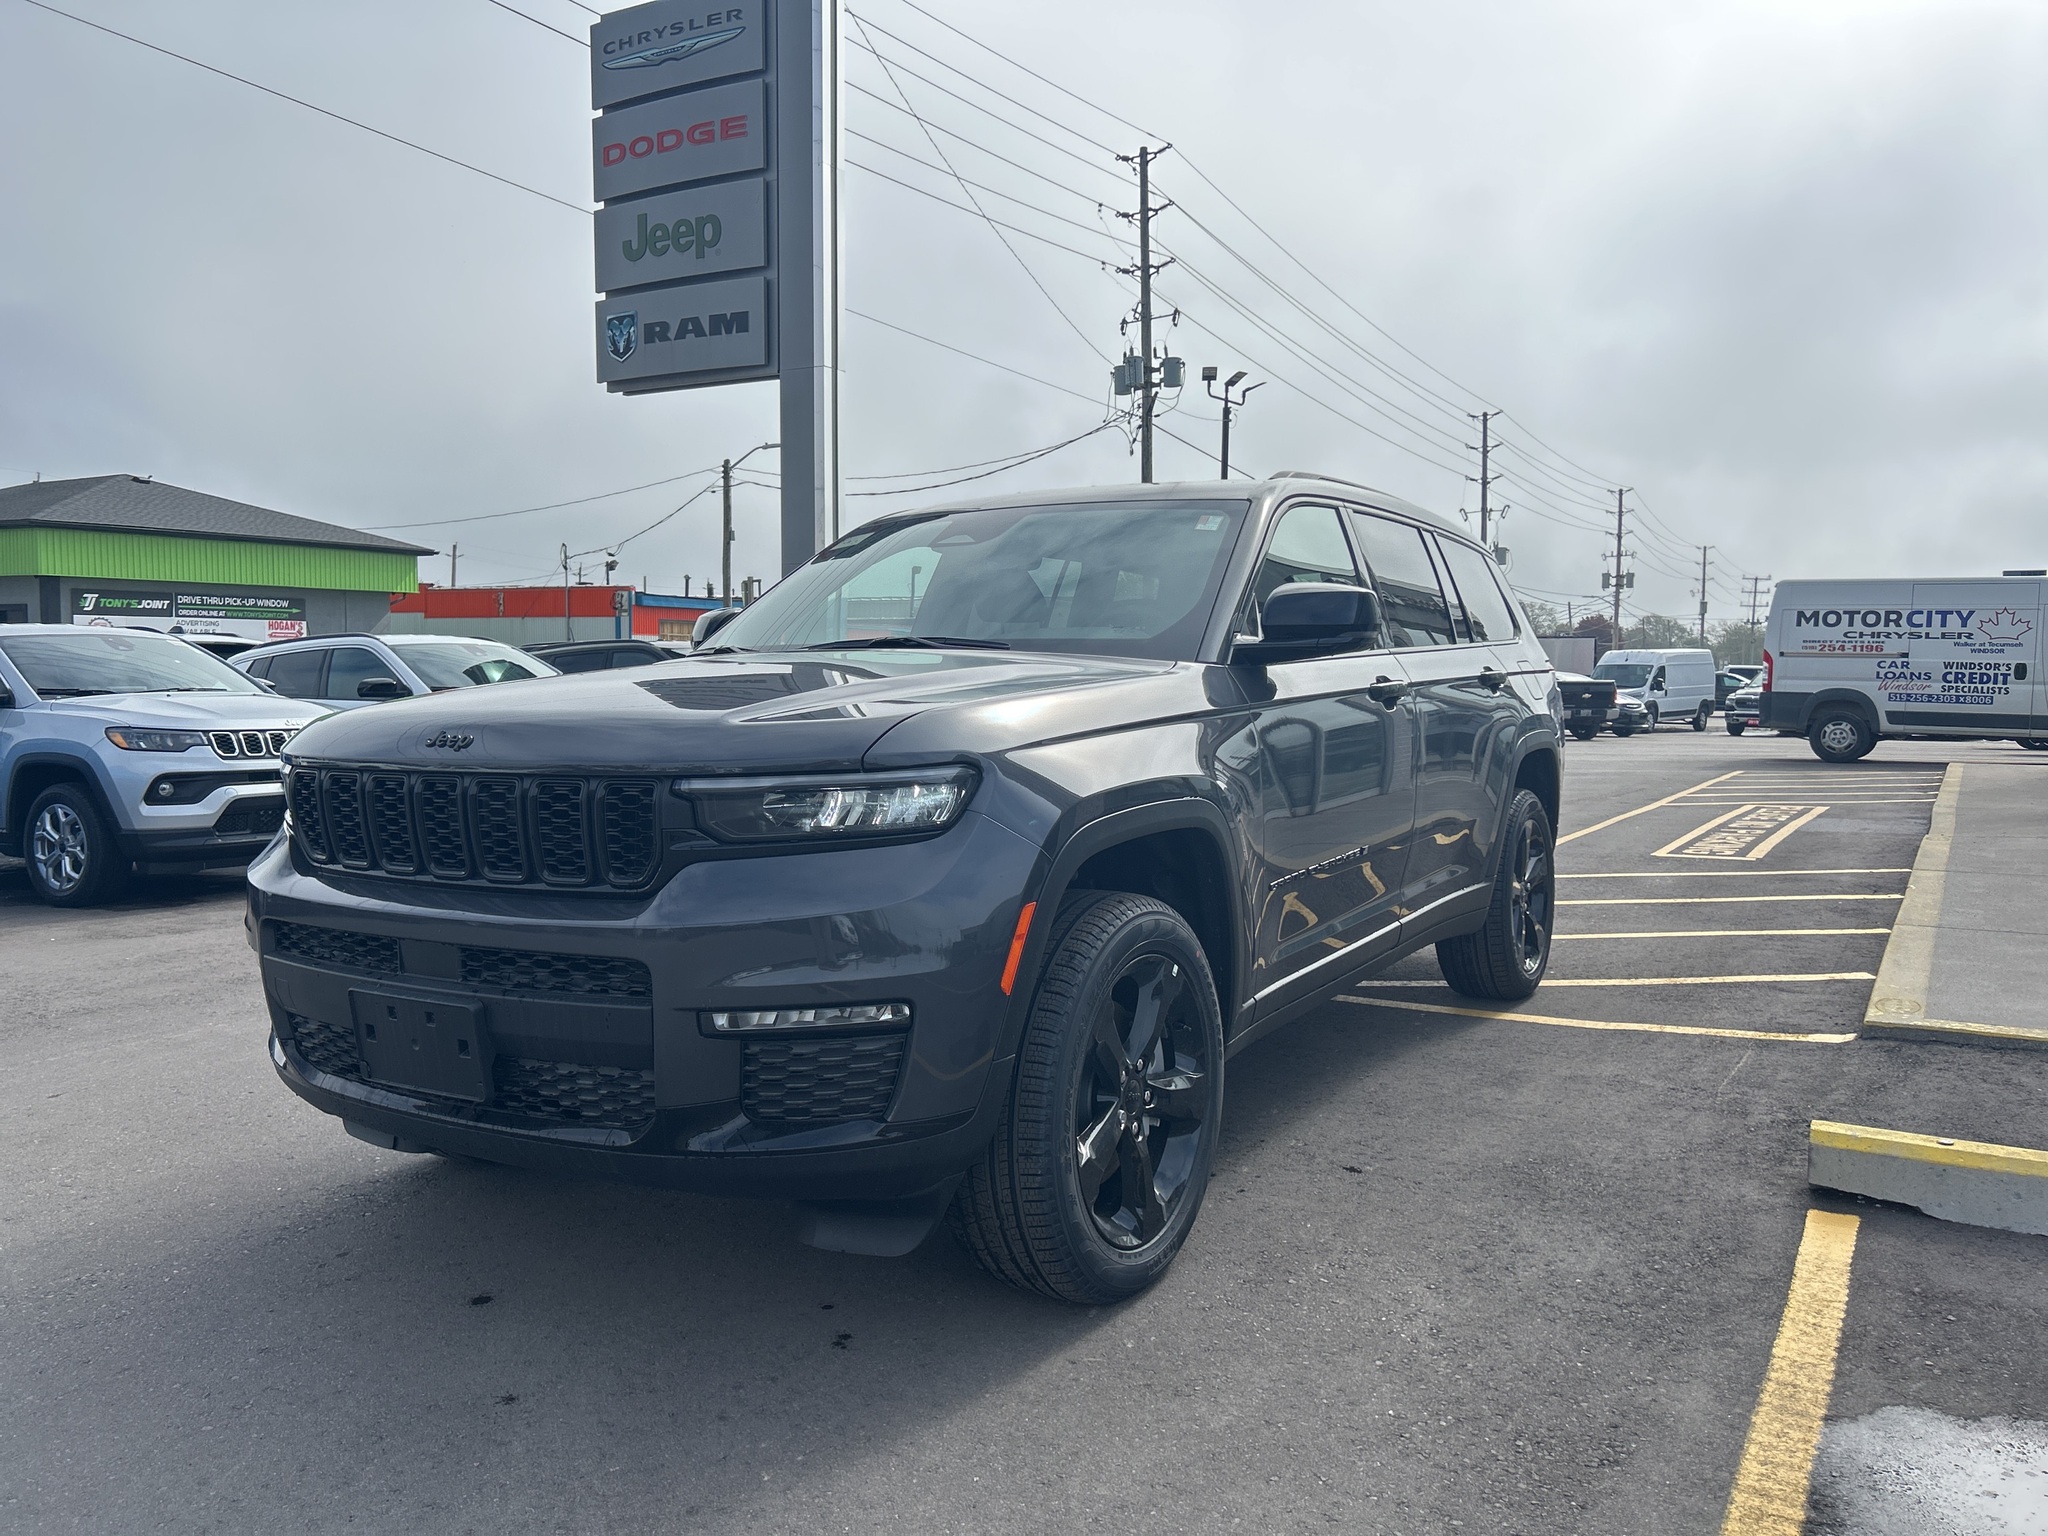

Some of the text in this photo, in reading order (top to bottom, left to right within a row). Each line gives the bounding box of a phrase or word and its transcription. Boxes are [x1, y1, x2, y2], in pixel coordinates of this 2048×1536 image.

[603, 8, 743, 54] CHRYSLER
[603, 115, 748, 167] DODGE
[622, 213, 722, 262] Jeep
[643, 310, 749, 345] RAM
[177, 595, 289, 608] DRIVE THRU PICK-UP WINDOW
[268, 620, 303, 631] HOGAN'S
[1843, 631, 1974, 640] CHRYSLER
[1818, 644, 1884, 652] 254-1196
[1876, 660, 1910, 669] CAR
[1943, 661, 2012, 672] WINDSOR'S
[1875, 671, 1932, 680] LOANS
[1941, 671, 2012, 686] CREDIT
[1877, 677, 1932, 691] Windsor
[1940, 685, 2010, 696] SPECIALISTS
[1890, 693, 1956, 703] 519-256-2303
[425, 730, 475, 751] Jeep
